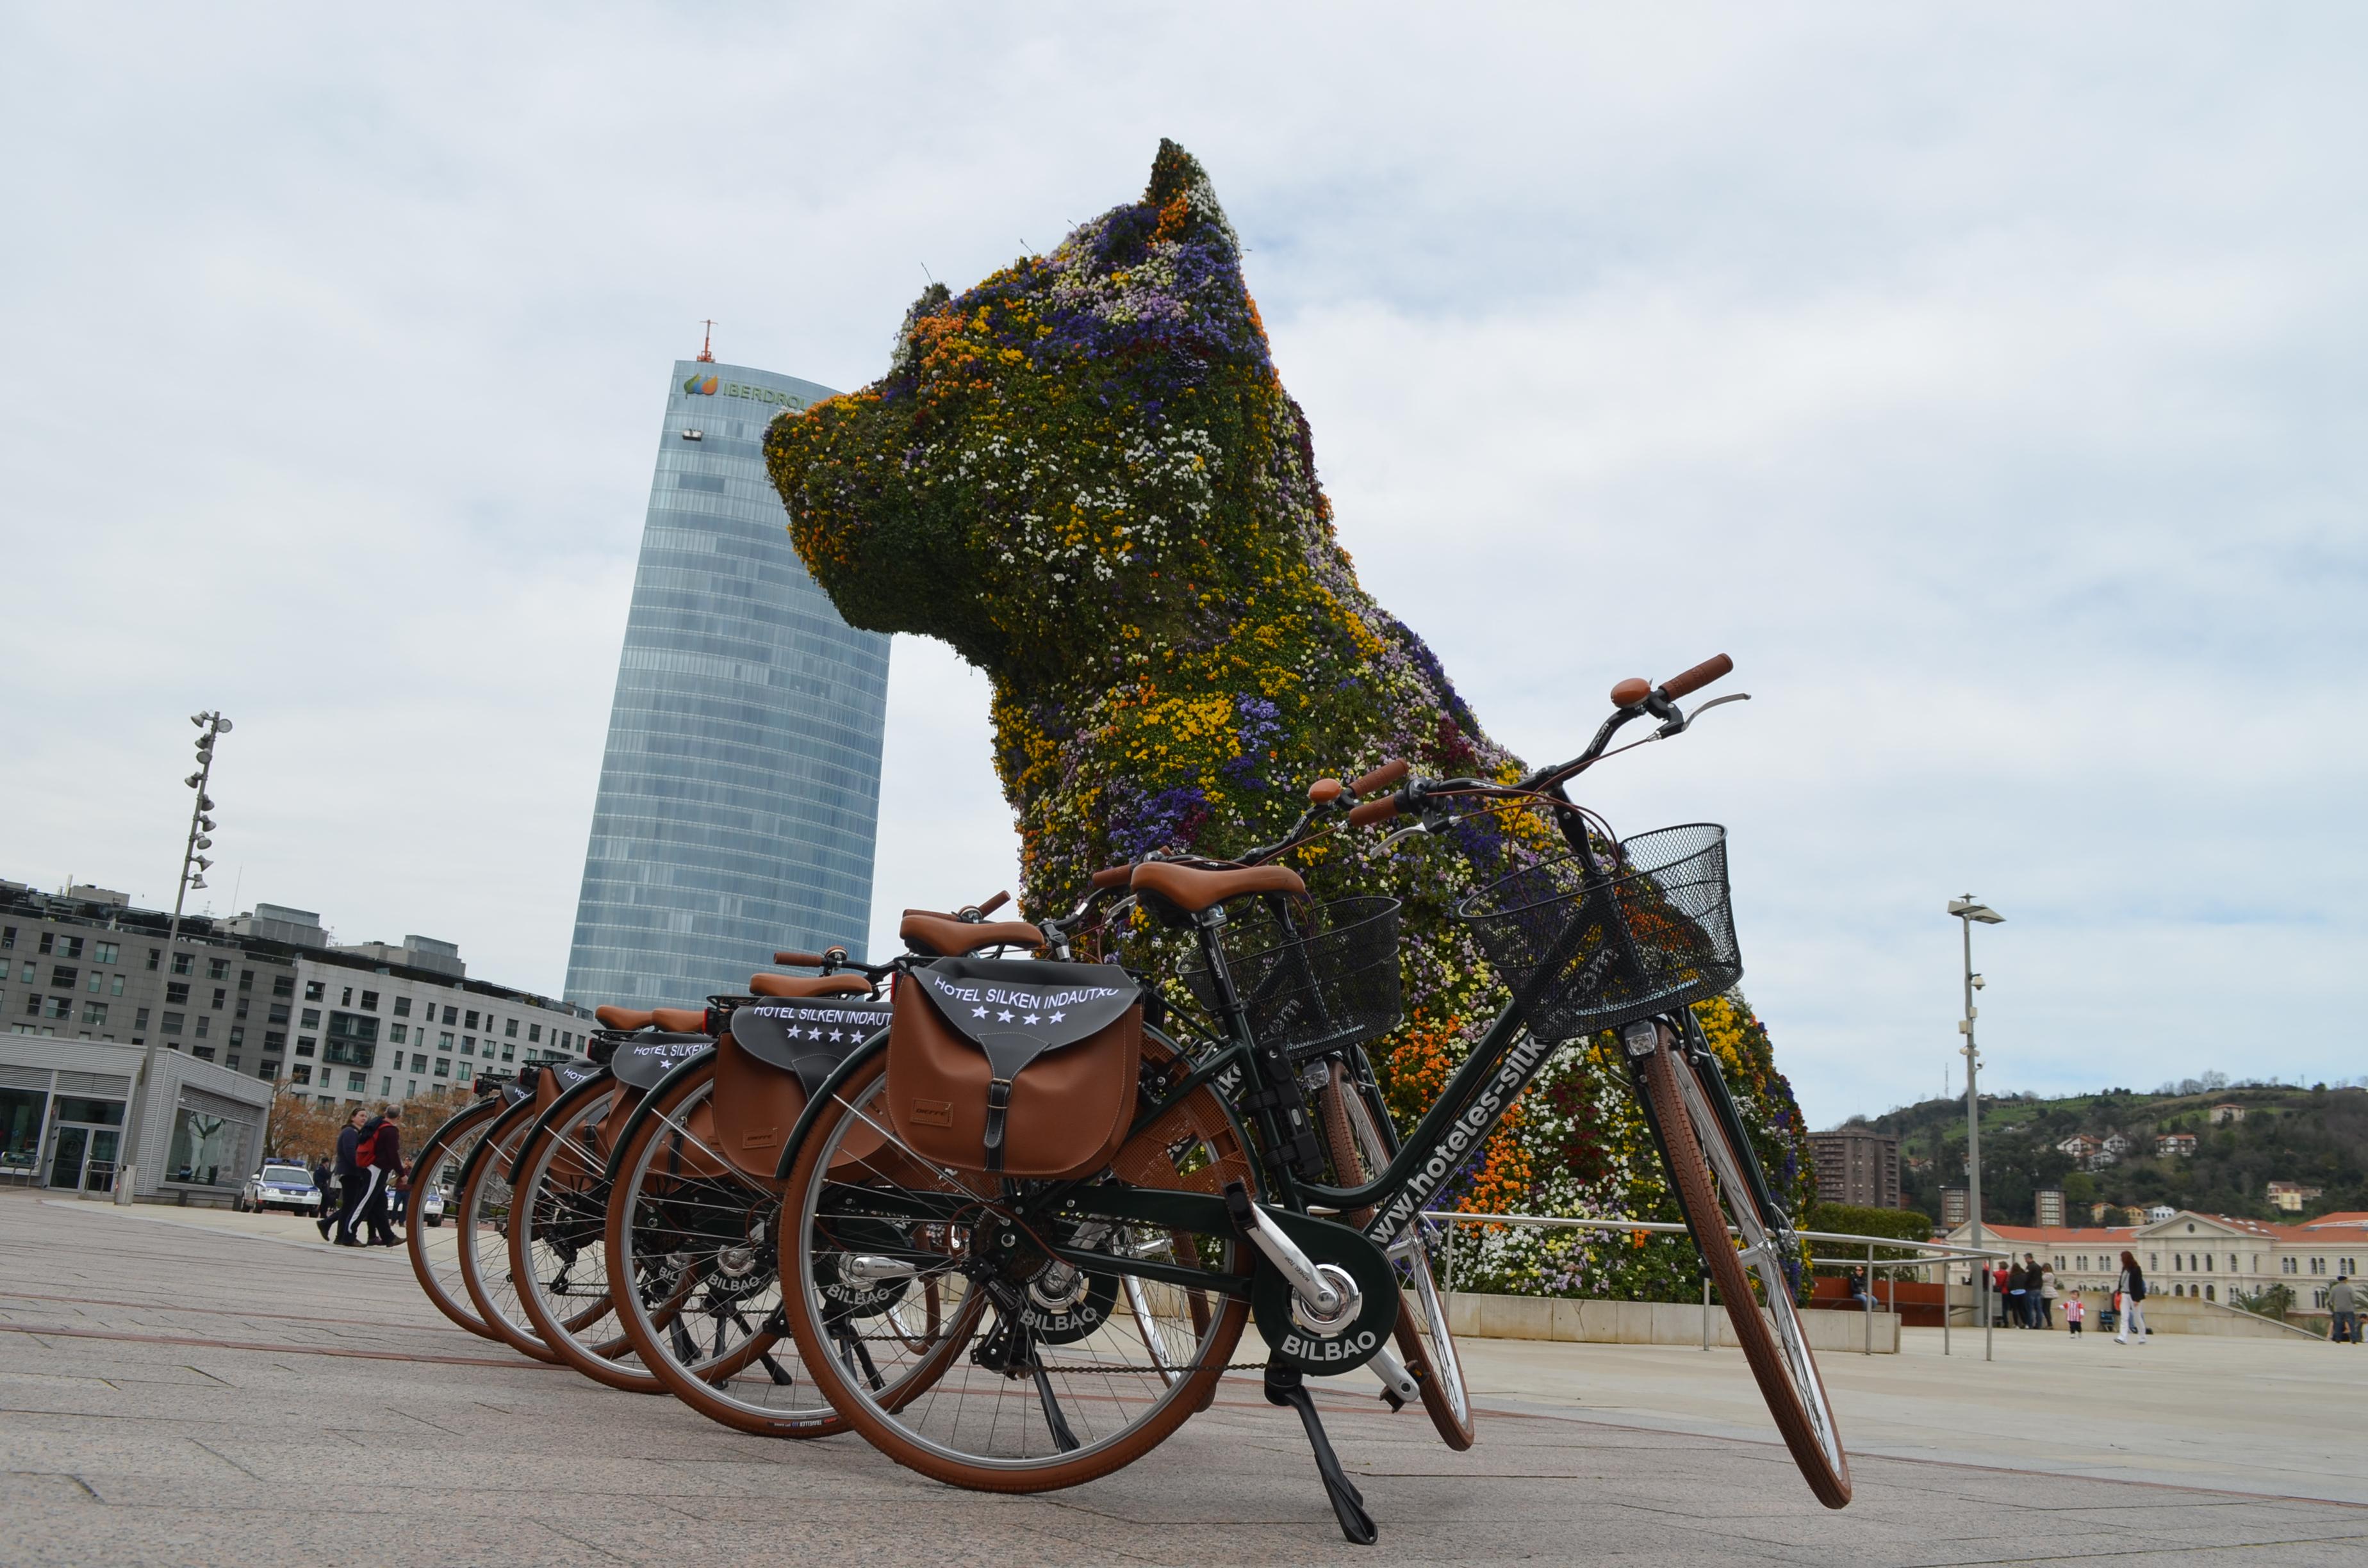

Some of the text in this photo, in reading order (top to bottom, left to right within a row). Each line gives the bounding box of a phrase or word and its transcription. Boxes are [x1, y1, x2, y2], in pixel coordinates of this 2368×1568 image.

[723, 382, 805, 411] IBERDROL
[934, 976, 981, 1002] HOTEL
[985, 988, 1041, 1009] SILKEN
[753, 1006, 893, 1025] HOTEL SILKEN INDAUT
[633, 1045, 668, 1056] HOTEL
[659, 1266, 682, 1282] BIL
[707, 1273, 760, 1292] BILBAO
[826, 1284, 891, 1305] BILBAO
[1019, 1307, 1098, 1332] BILBAO
[1281, 1330, 1376, 1362] BILBAO
